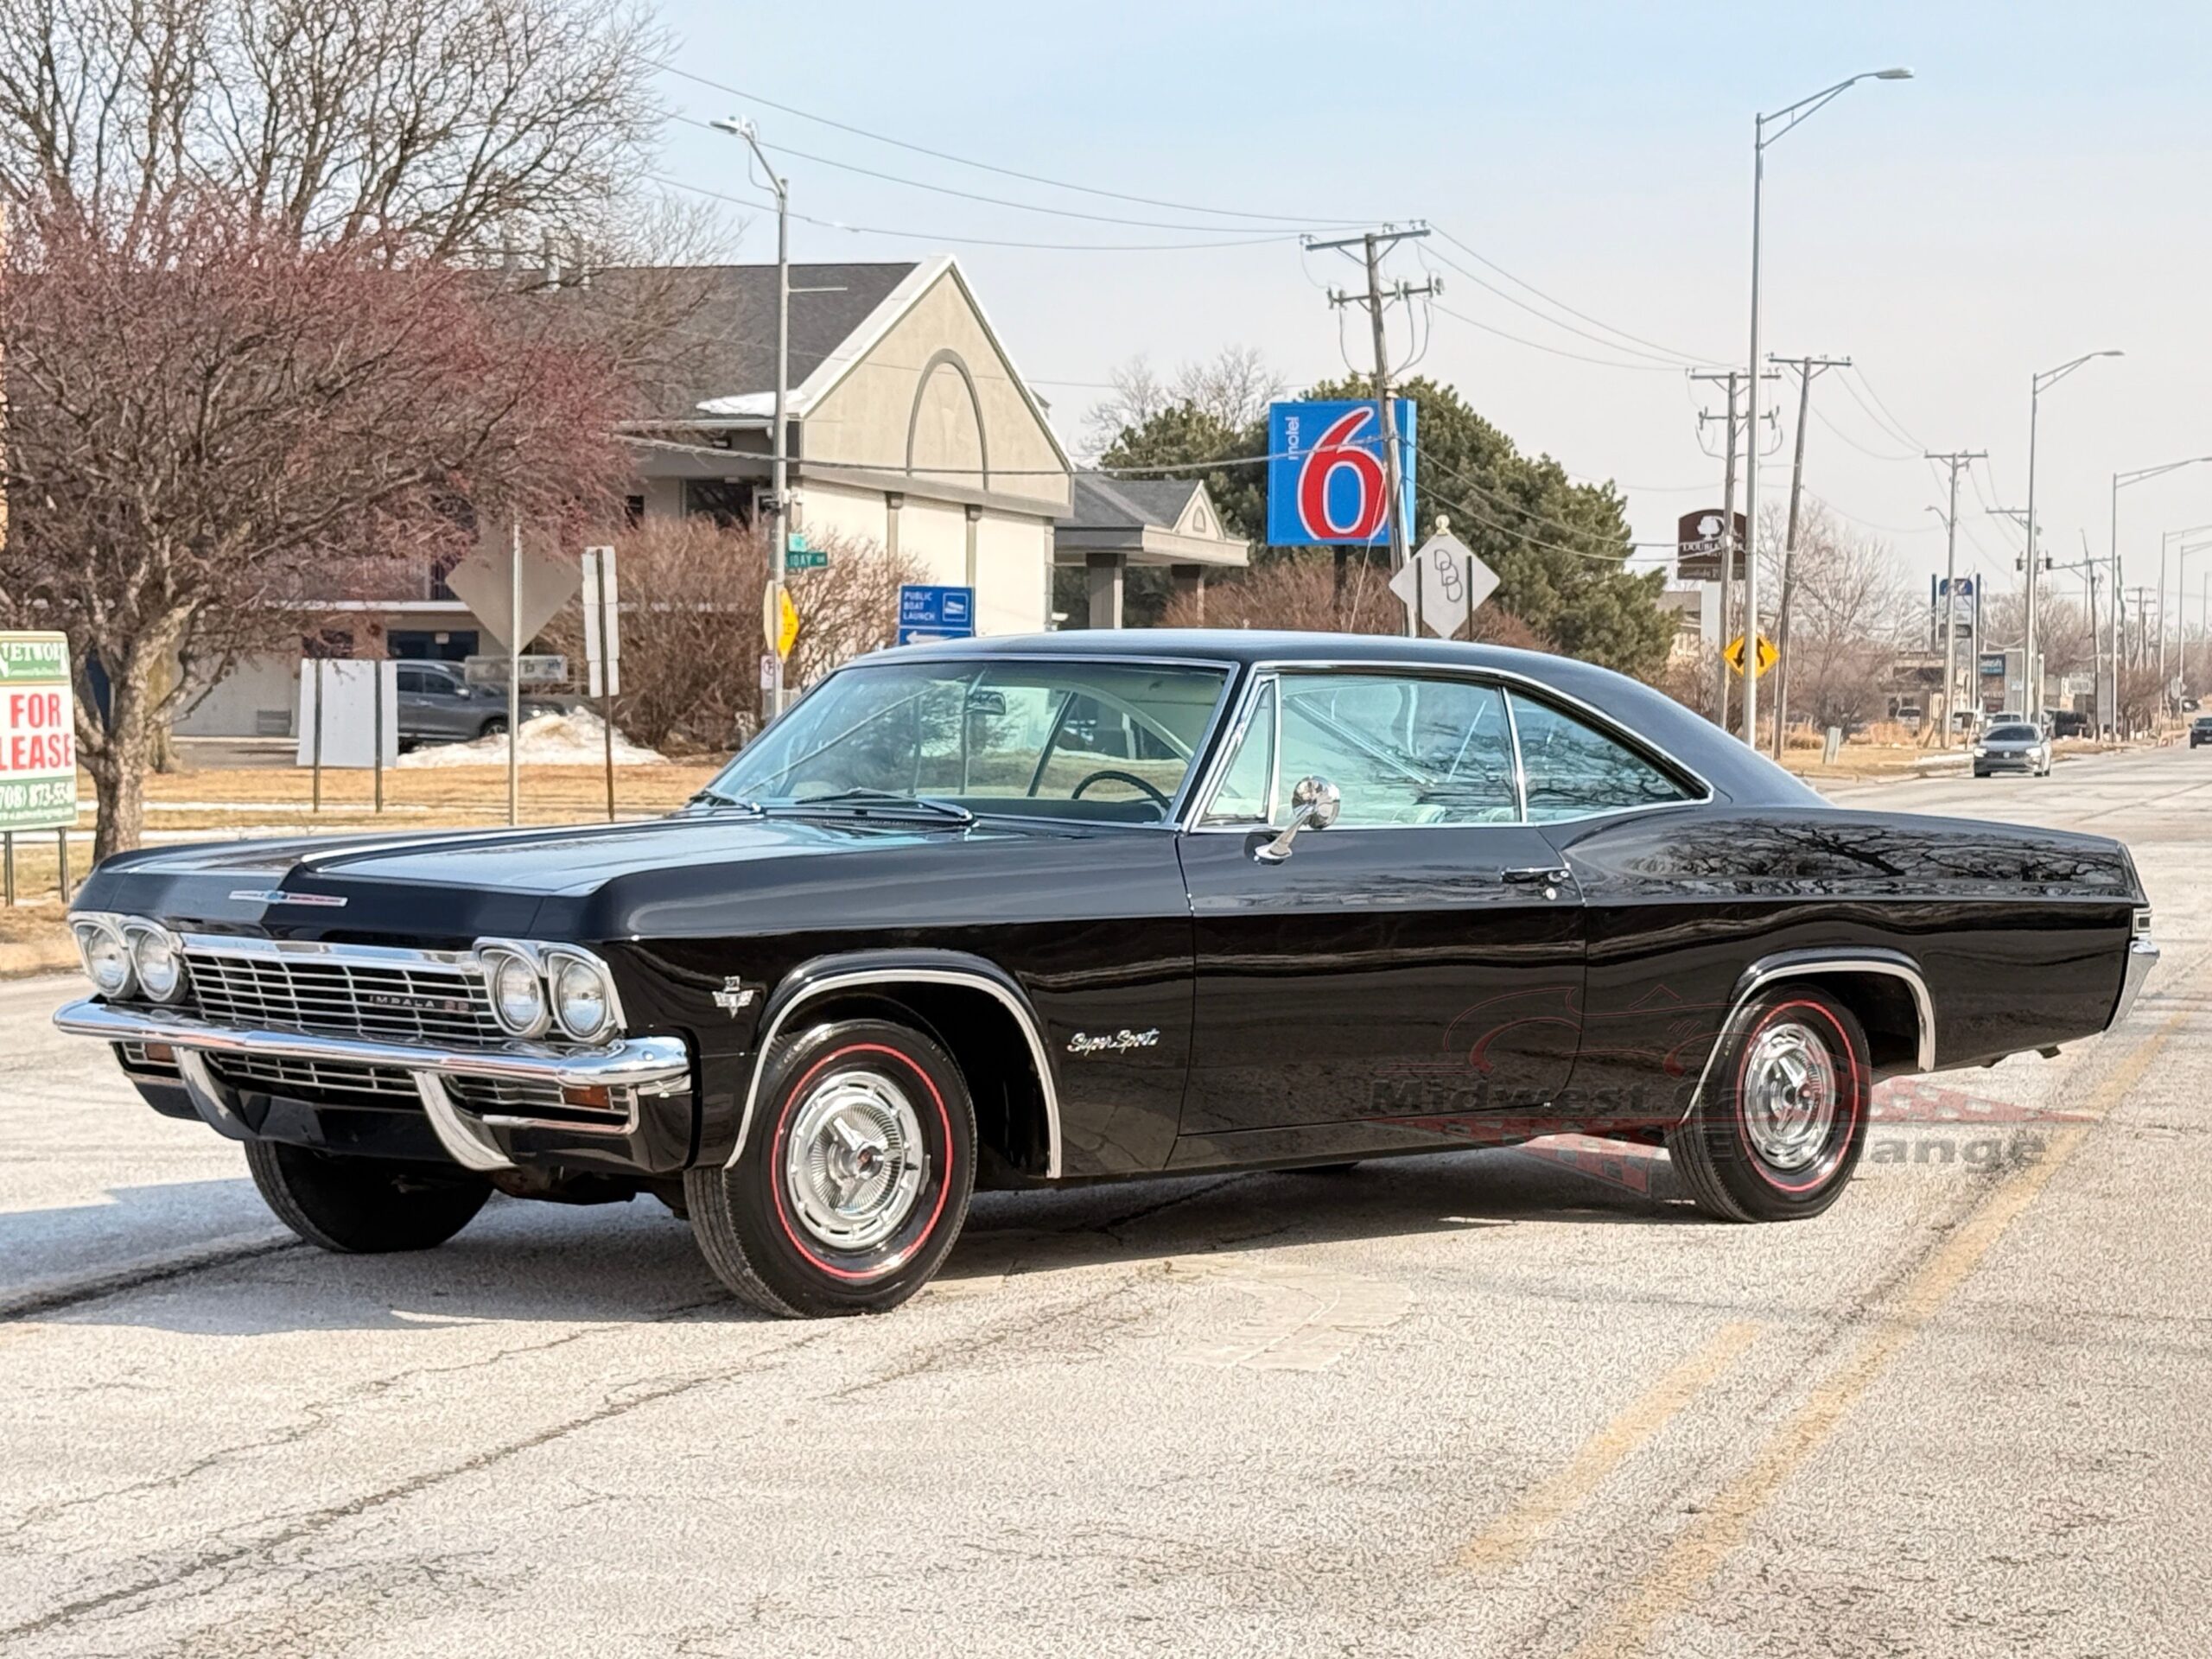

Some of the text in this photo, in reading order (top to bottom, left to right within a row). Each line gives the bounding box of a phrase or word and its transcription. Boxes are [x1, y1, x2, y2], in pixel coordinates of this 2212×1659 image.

[1285, 416, 1300, 461] motel
[1297, 406, 1389, 541] 6
[904, 591, 932, 601] PUBLIC
[904, 601, 925, 610] BOAT
[903, 612, 935, 621] LAUNCH
[10, 693, 61, 728] FOR
[0, 734, 73, 771] LEASE
[368, 995, 435, 1008] IMPALA
[1066, 1027, 1160, 1057] Super Sport
